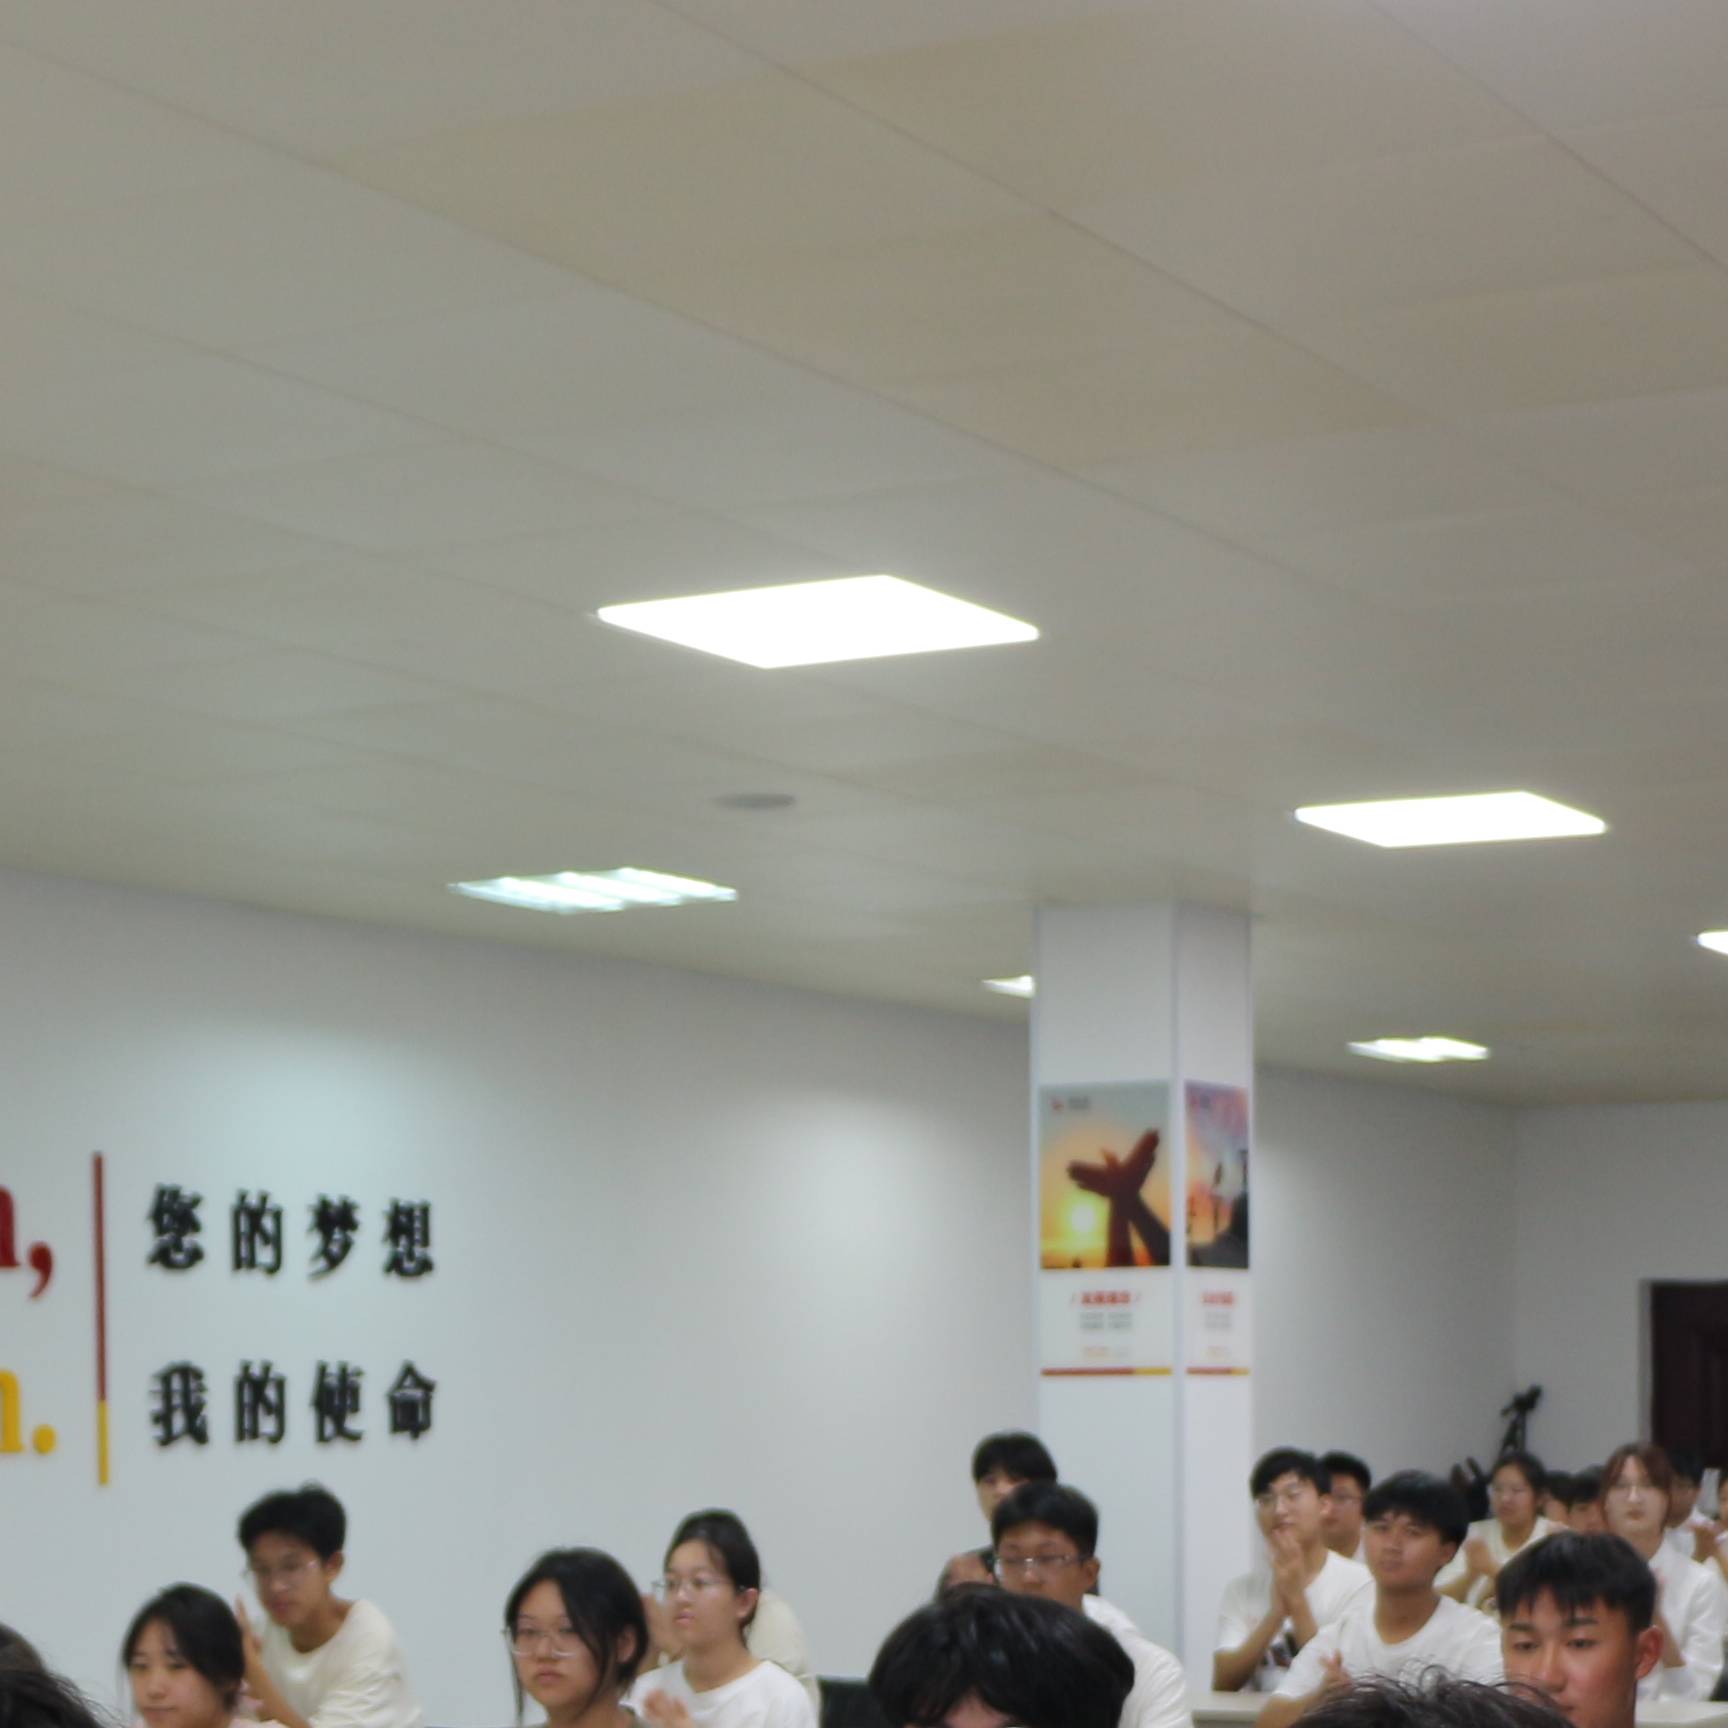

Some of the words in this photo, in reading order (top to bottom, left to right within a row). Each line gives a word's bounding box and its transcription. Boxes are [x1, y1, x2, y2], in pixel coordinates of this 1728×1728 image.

[147, 1183, 435, 1280] 您的梦想
[148, 1360, 437, 1447] 我的使命
